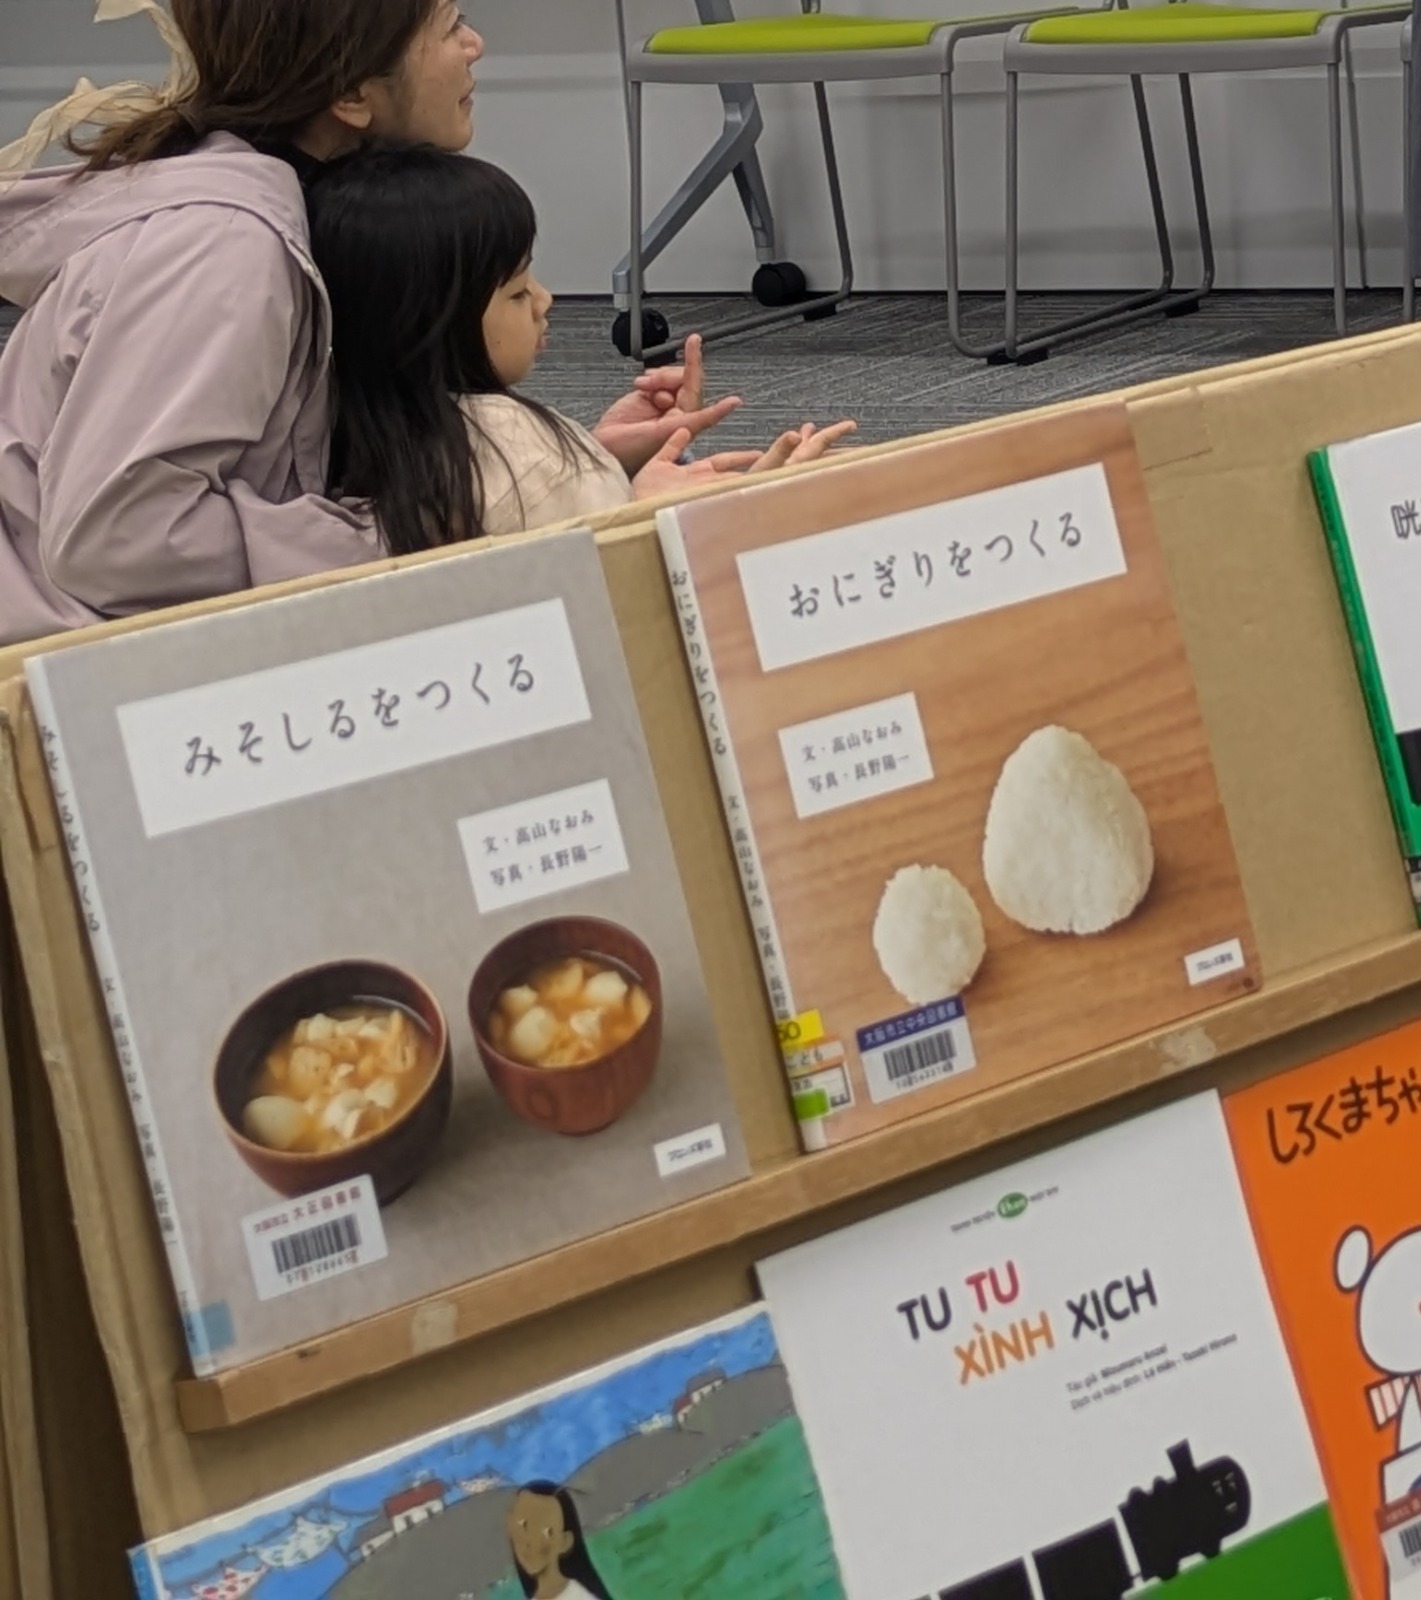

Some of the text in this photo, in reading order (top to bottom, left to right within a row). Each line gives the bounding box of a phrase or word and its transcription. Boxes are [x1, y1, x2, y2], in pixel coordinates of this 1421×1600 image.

[788, 511, 1084, 619] おにぎりをつくる
[671, 569, 728, 758] おにぎりをつくる
[183, 653, 536, 777] みそしるをつくる
[801, 720, 904, 763] 文・高山なおみ
[807, 751, 910, 794] 写真・長野陽一
[482, 807, 595, 854] 文・高山なおみ
[489, 843, 604, 888] 写真・長野陽一
[864, 1001, 958, 1046] 大阪市立中央図書館
[896, 1260, 1021, 1341] TU TU
[954, 1269, 1159, 1386] XÌNH XỊCH
